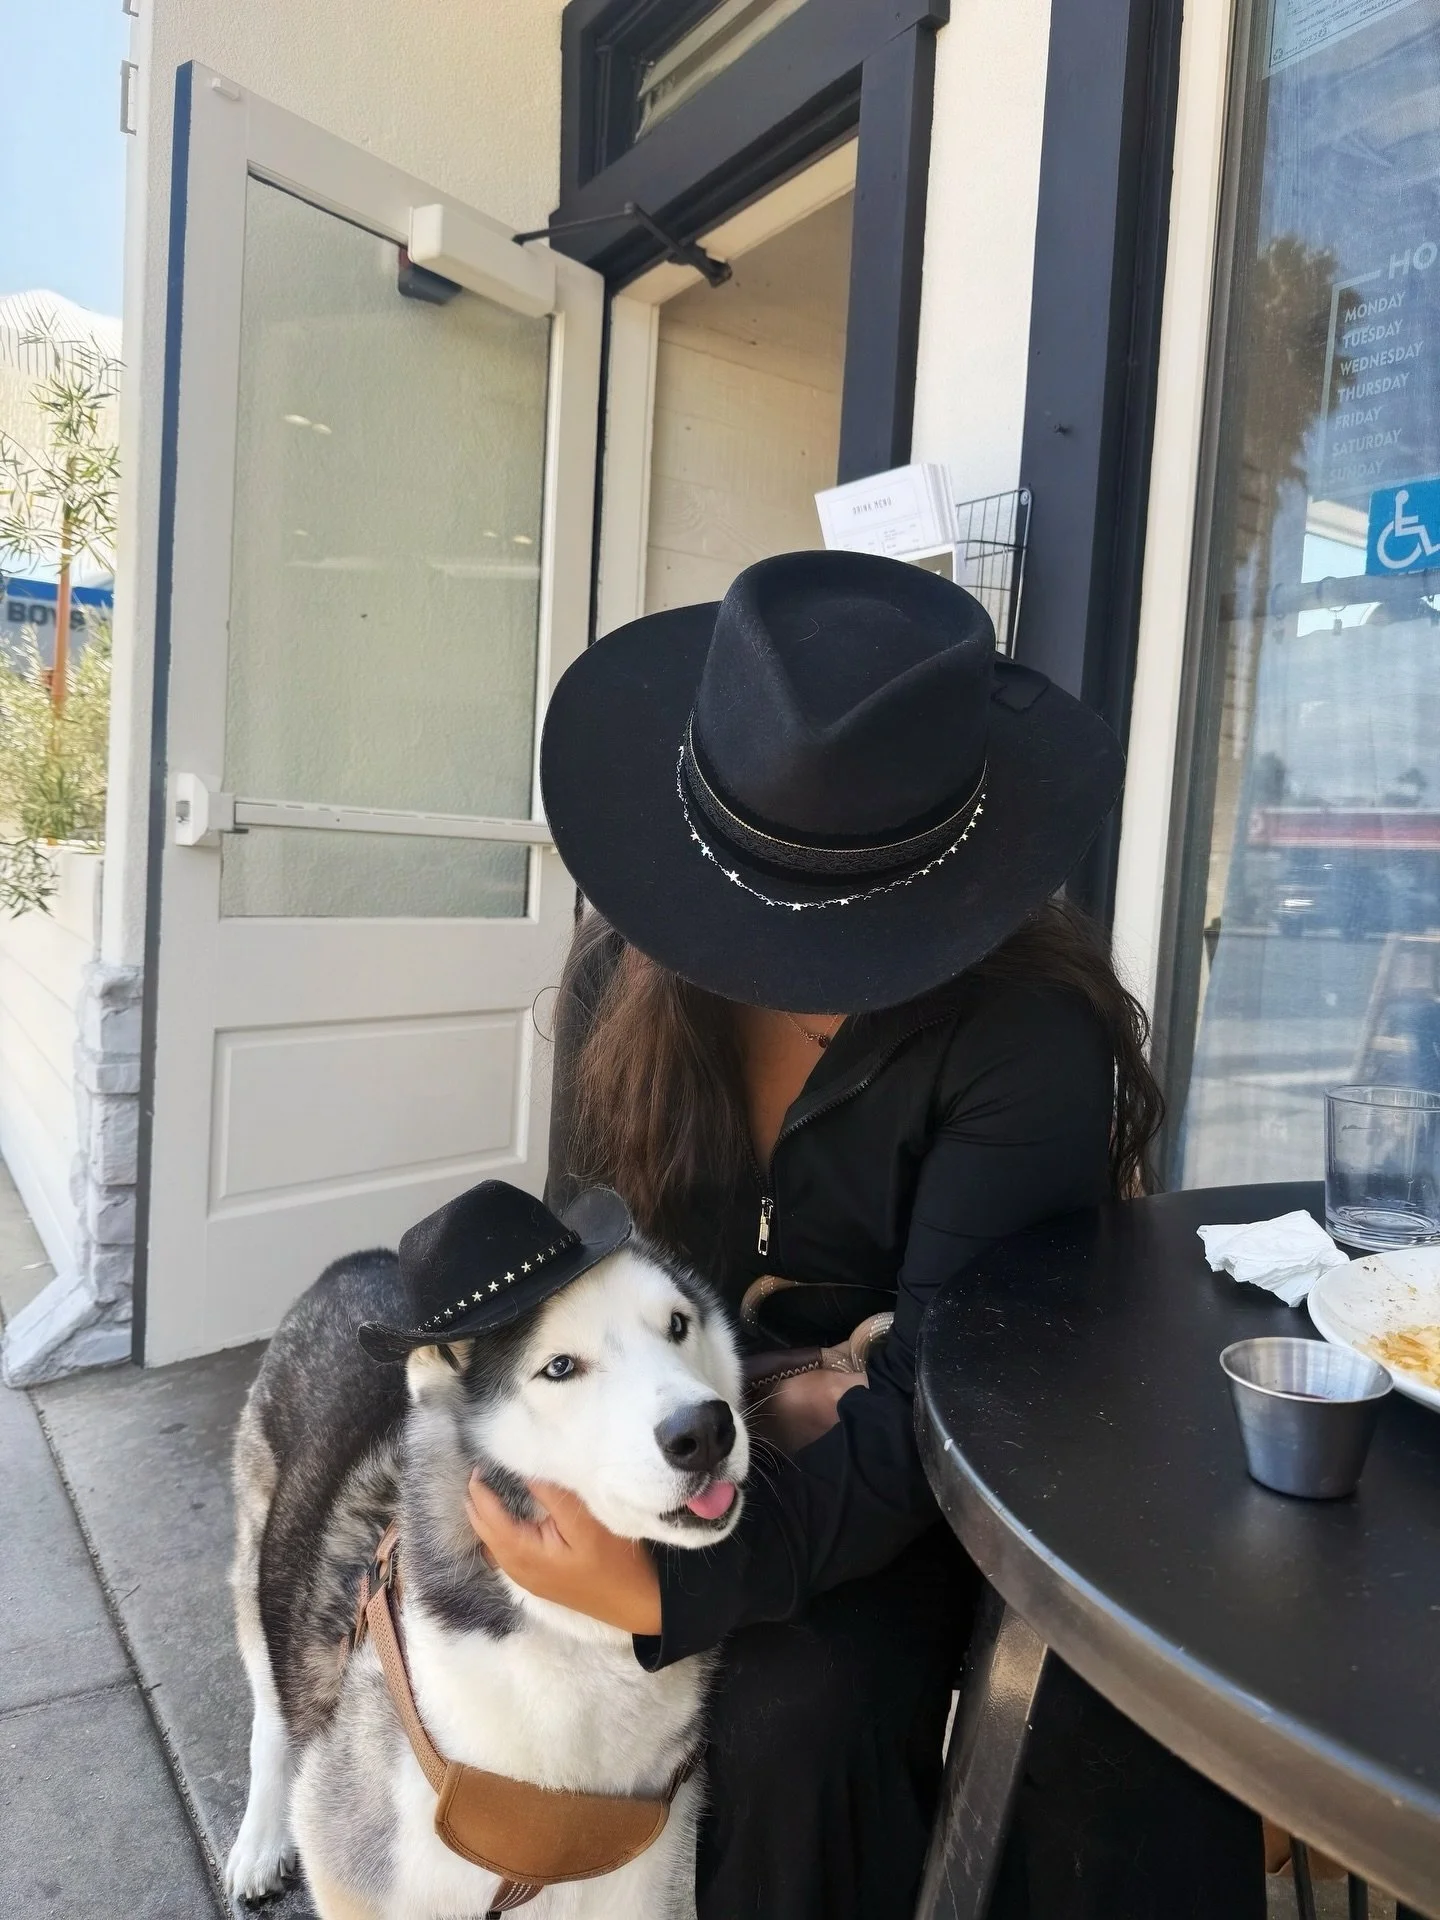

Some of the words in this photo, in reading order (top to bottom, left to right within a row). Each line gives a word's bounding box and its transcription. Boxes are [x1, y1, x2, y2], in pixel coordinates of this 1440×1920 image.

[1388, 241, 1438, 280] HO
[1344, 292, 1406, 323] MONDAY
[1342, 319, 1403, 348] TUESDAY
[1340, 340, 1424, 377] WEDNESDAY
[1337, 372, 1410, 403] THURSDAY
[1334, 405, 1383, 431] FRIDAY
[1332, 427, 1403, 457] SATURDAY
[1329, 460, 1384, 483] SUNDAY
